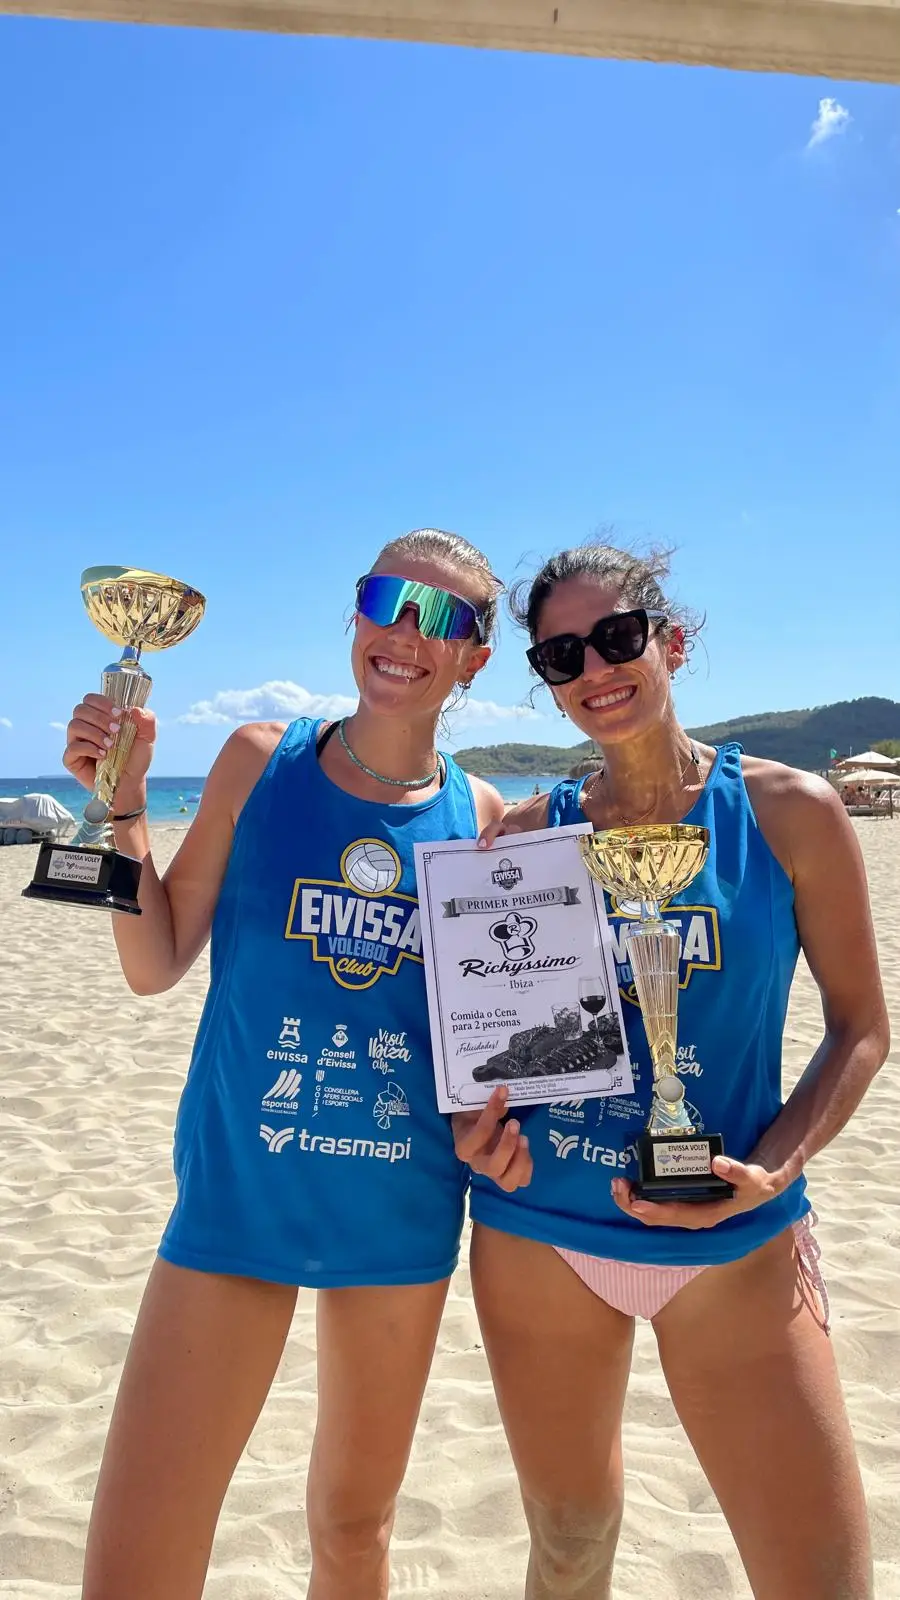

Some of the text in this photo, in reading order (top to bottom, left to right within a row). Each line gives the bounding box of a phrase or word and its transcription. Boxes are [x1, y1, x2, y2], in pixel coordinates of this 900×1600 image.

[65, 853, 84, 861] EIVISSA
[61, 873, 96, 881] CLASIFICADO
[493, 869, 520, 882] EIVISSA
[467, 891, 555, 910] PRIMER PREMIO
[301, 888, 422, 954] EIVISSA
[508, 924, 519, 934] R
[328, 936, 389, 964] VOLEIBOL
[336, 957, 376, 977] Club
[509, 979, 534, 989] Ibiza
[450, 1010, 484, 1021] Comida
[494, 1008, 517, 1018] Cena
[452, 1019, 521, 1034] para 2 personas
[378, 1028, 408, 1047] Visit
[266, 1049, 308, 1064] eivissa
[321, 1048, 355, 1059] Consell
[368, 1037, 412, 1063] Ibiza
[317, 1058, 357, 1070] d'Eivissa
[323, 1086, 360, 1096] CONSELLERIA
[325, 1100, 349, 1108] ESPORTS
[340, 1095, 364, 1103] SOCIALS
[298, 1128, 412, 1163] trasmapi
[667, 1144, 689, 1152] EIVISSA
